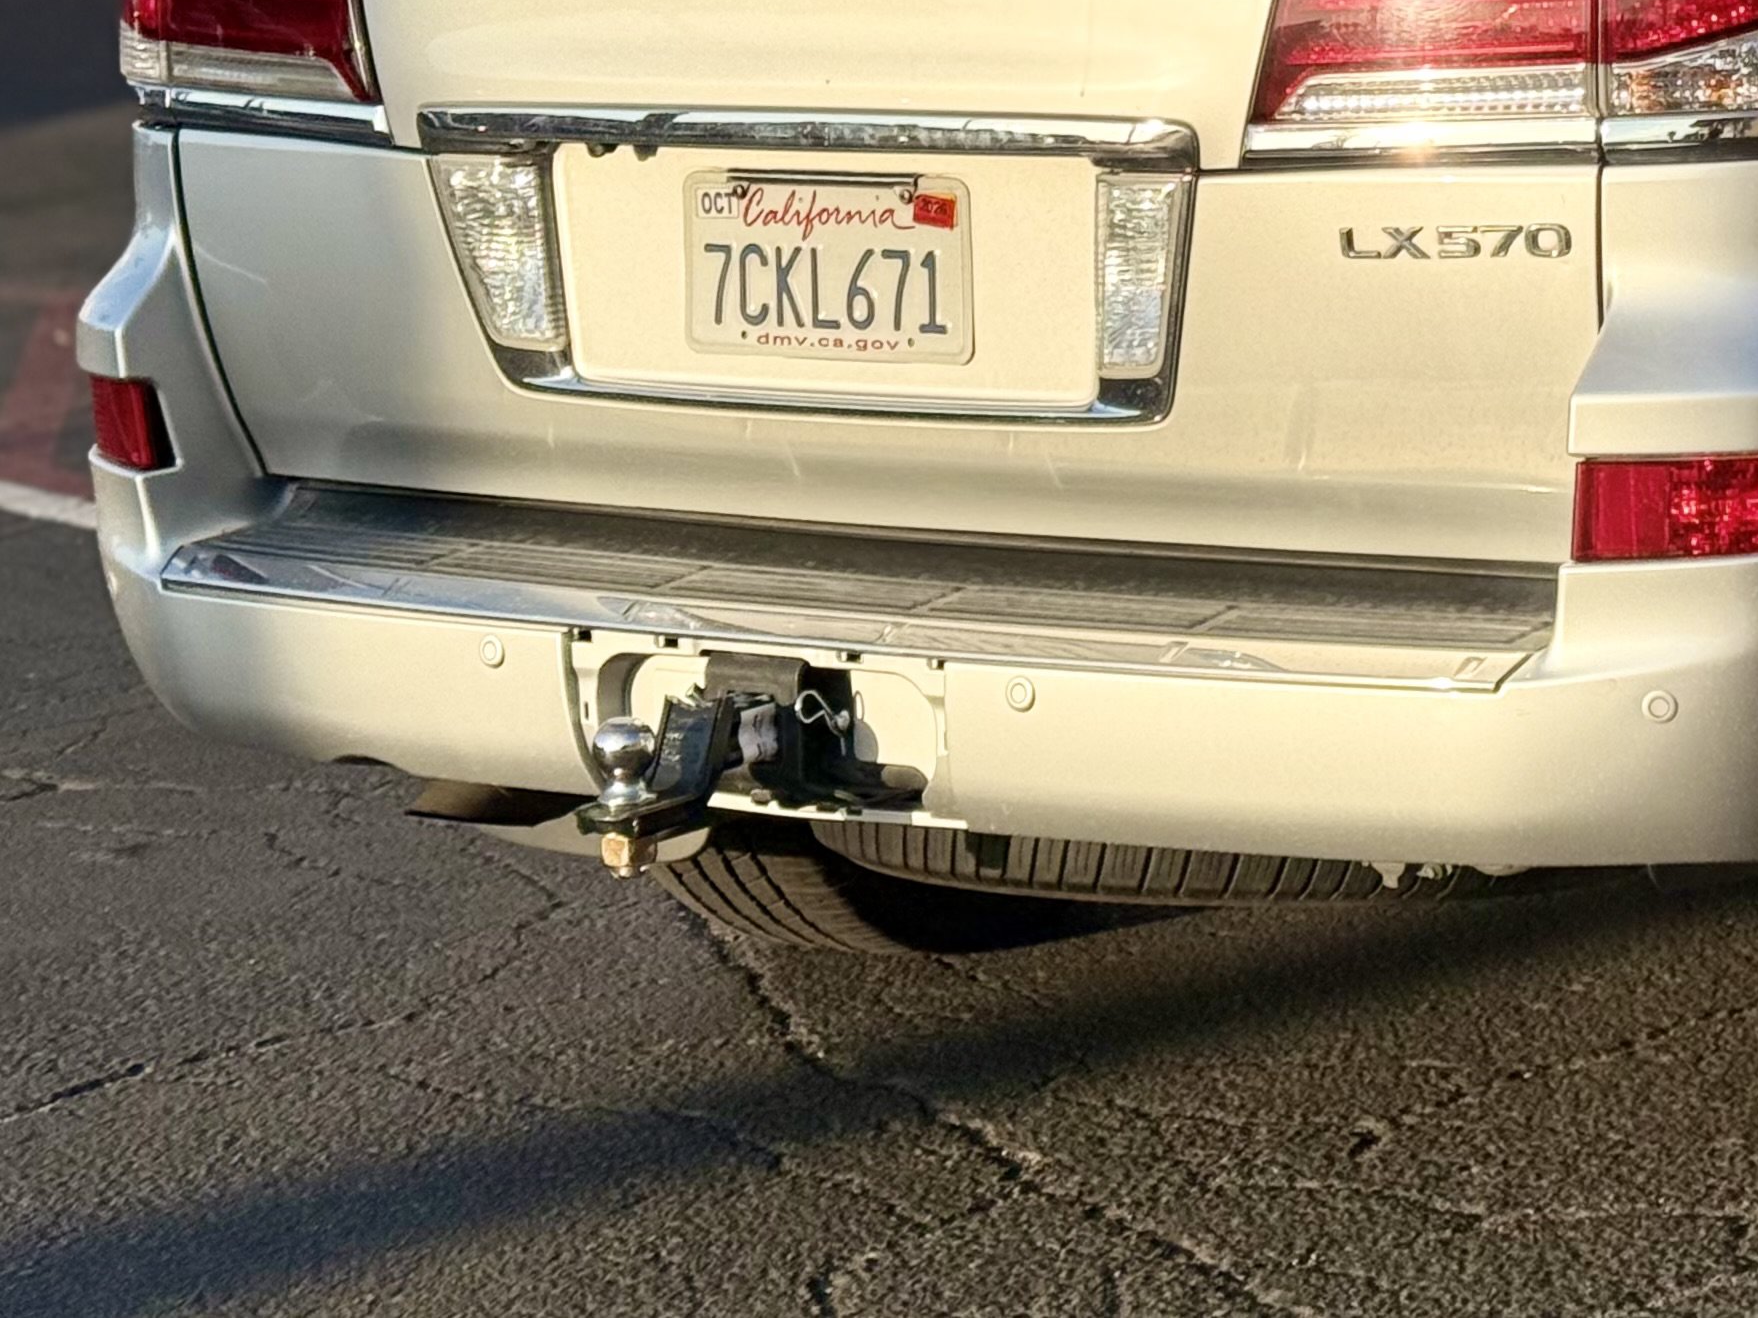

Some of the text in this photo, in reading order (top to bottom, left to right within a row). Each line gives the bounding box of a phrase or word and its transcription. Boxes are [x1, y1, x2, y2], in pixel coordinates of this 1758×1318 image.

[701, 192, 741, 215] OCT
[743, 187, 916, 241] California
[704, 243, 948, 335] 7CKL671
[756, 331, 900, 351] dmv.ca.gov
